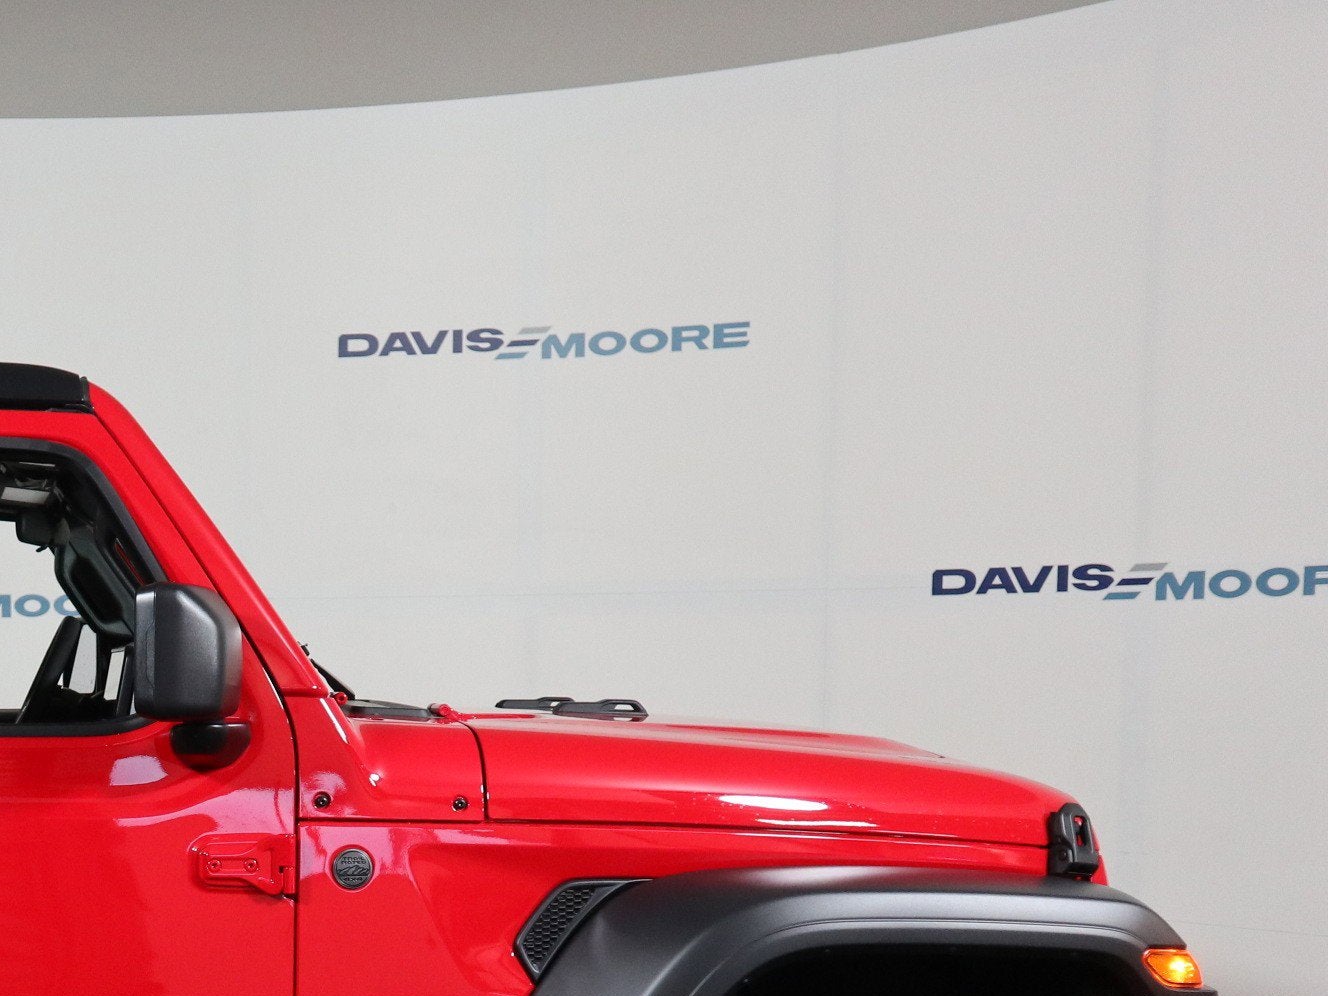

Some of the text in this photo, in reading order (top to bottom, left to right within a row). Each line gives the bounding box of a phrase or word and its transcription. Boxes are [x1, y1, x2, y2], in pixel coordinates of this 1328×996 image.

[337, 321, 751, 360] DAVIS MOORE
[931, 563, 1115, 596] DAVIS
